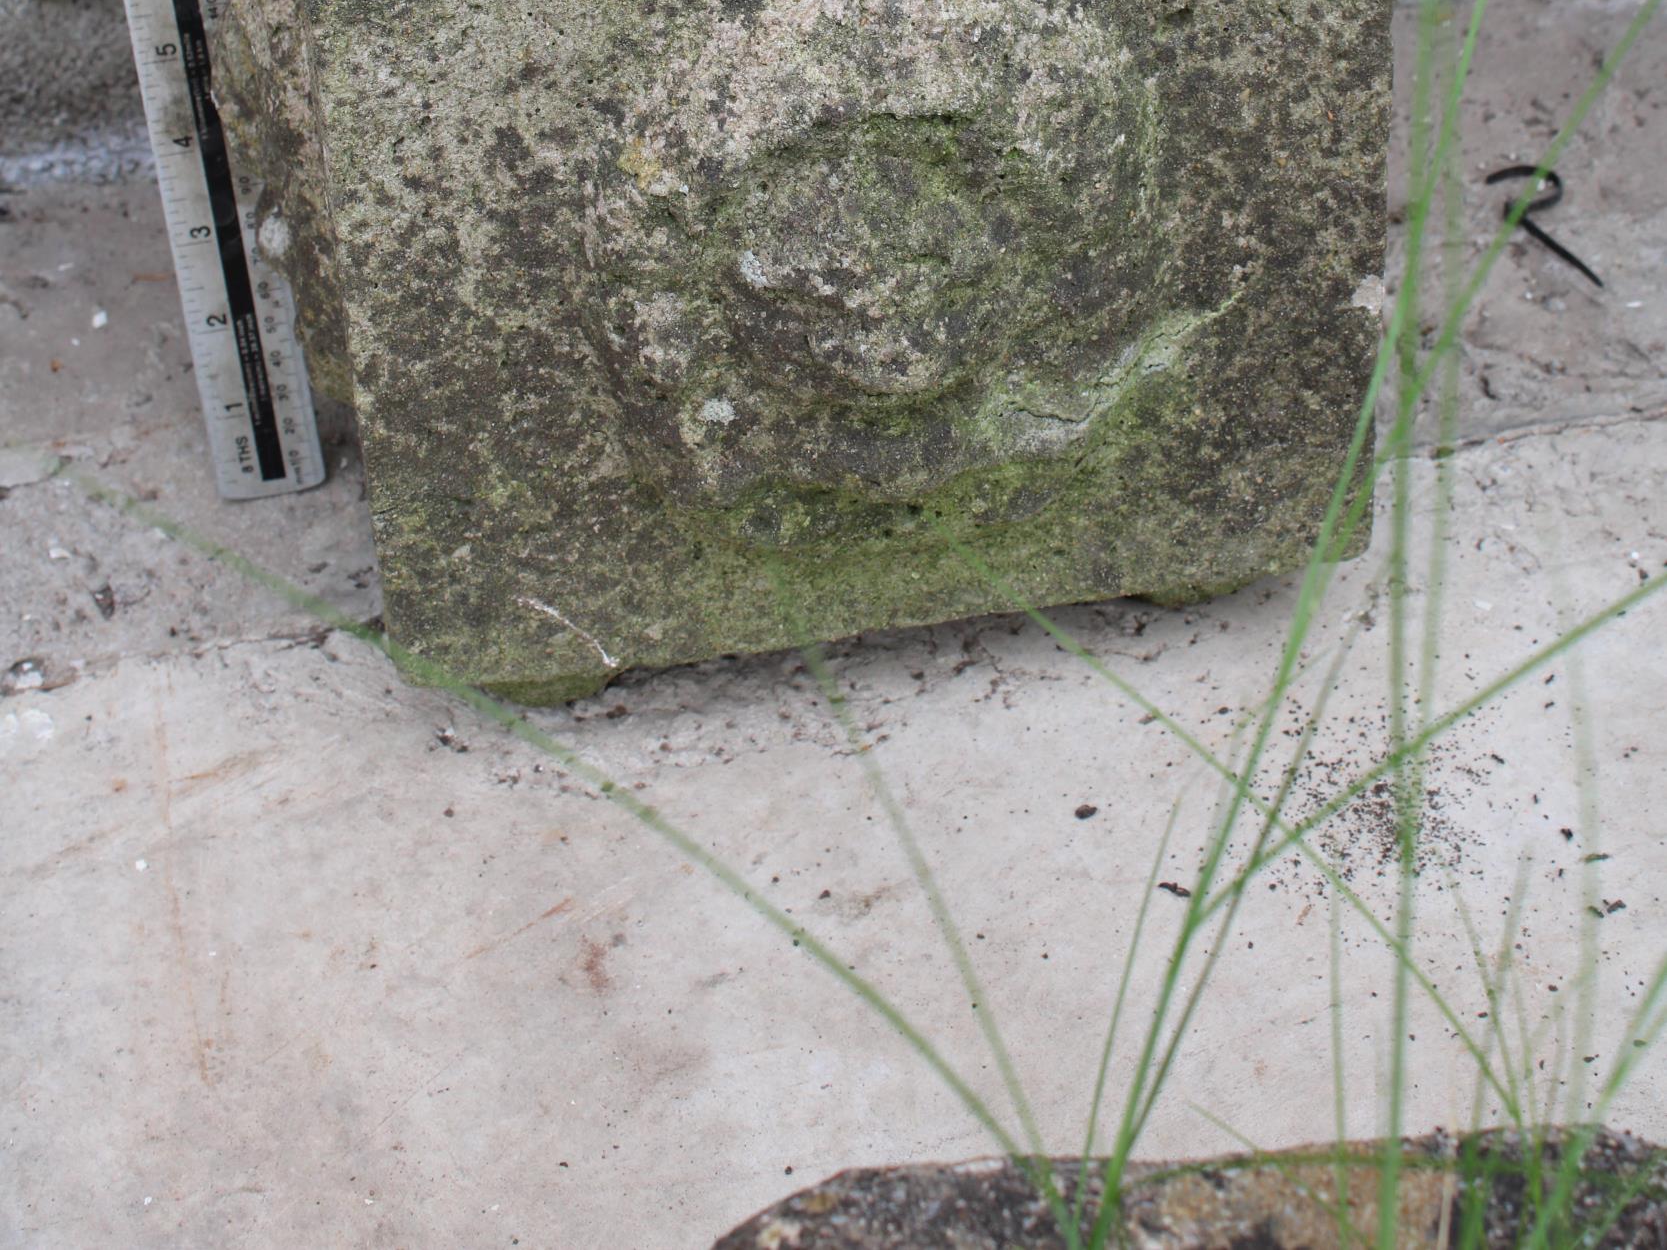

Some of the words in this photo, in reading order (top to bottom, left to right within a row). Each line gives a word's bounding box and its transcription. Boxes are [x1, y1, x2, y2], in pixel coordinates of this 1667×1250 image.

[155, 43, 177, 56] 5
[173, 136, 193, 148] 4
[190, 226, 211, 239] 3
[258, 281, 270, 300] 60
[206, 313, 227, 327] 2
[265, 316, 275, 334] 50
[271, 350, 282, 368] 40
[277, 384, 288, 402] 30
[225, 402, 243, 411] 1
[283, 417, 295, 435] 20
